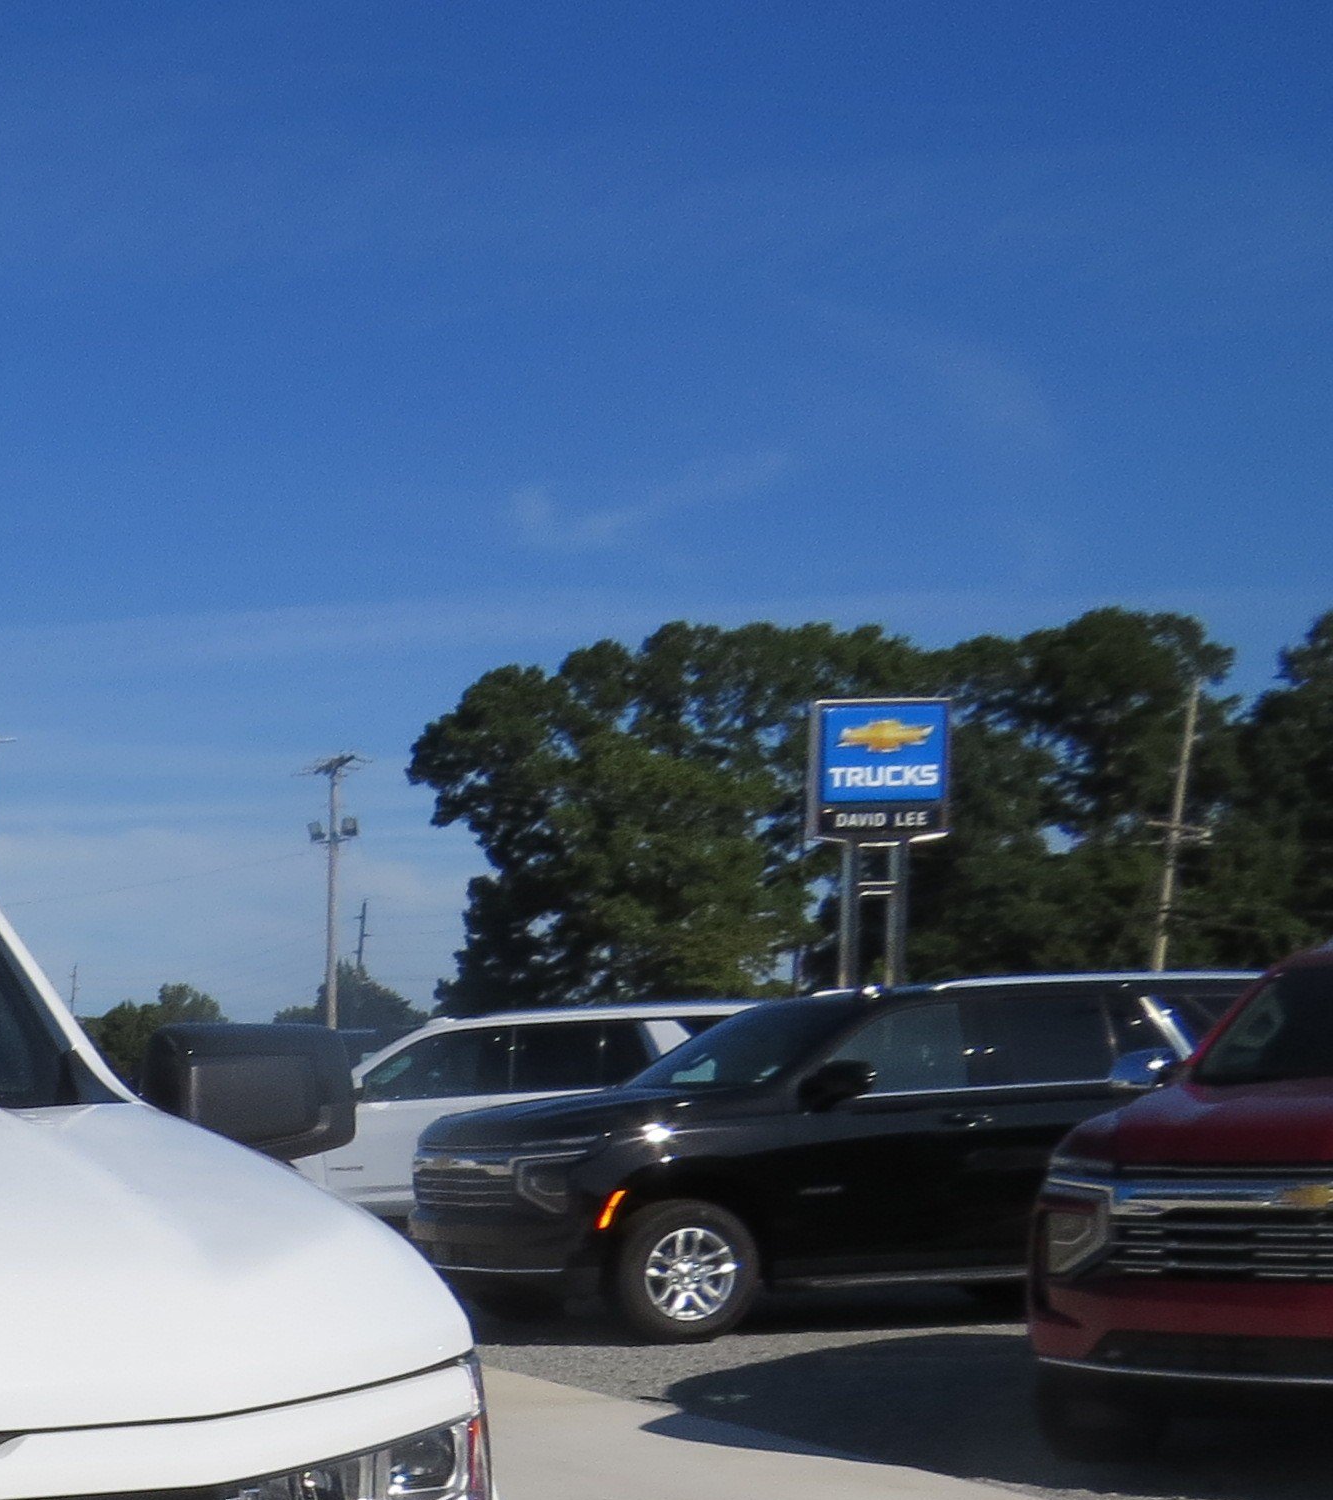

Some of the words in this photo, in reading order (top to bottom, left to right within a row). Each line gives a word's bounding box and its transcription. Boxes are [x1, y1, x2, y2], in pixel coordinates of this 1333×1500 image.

[829, 764, 939, 788] TRUCKS
[835, 812, 887, 828] DAVID
[894, 811, 928, 827] LEE
